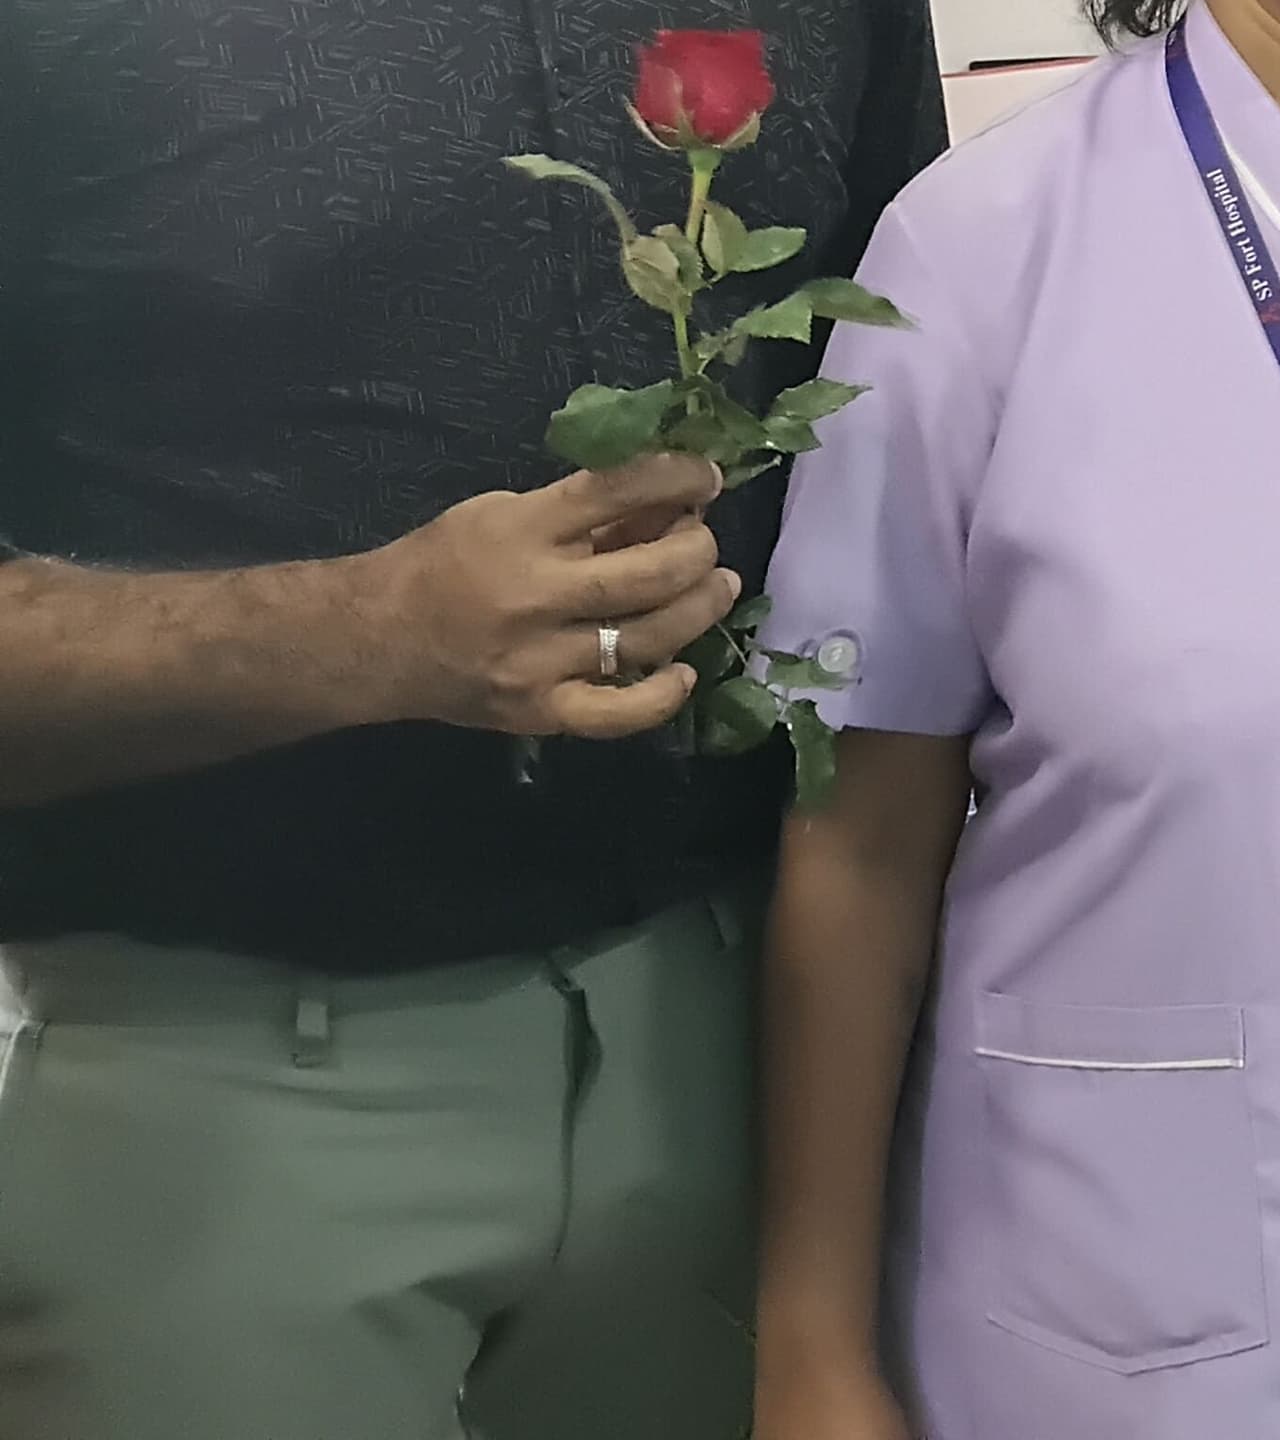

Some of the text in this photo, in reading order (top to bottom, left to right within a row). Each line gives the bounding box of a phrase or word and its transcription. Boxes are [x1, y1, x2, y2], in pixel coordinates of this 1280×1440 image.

[1206, 168, 1273, 302] SP Fort Hospital
